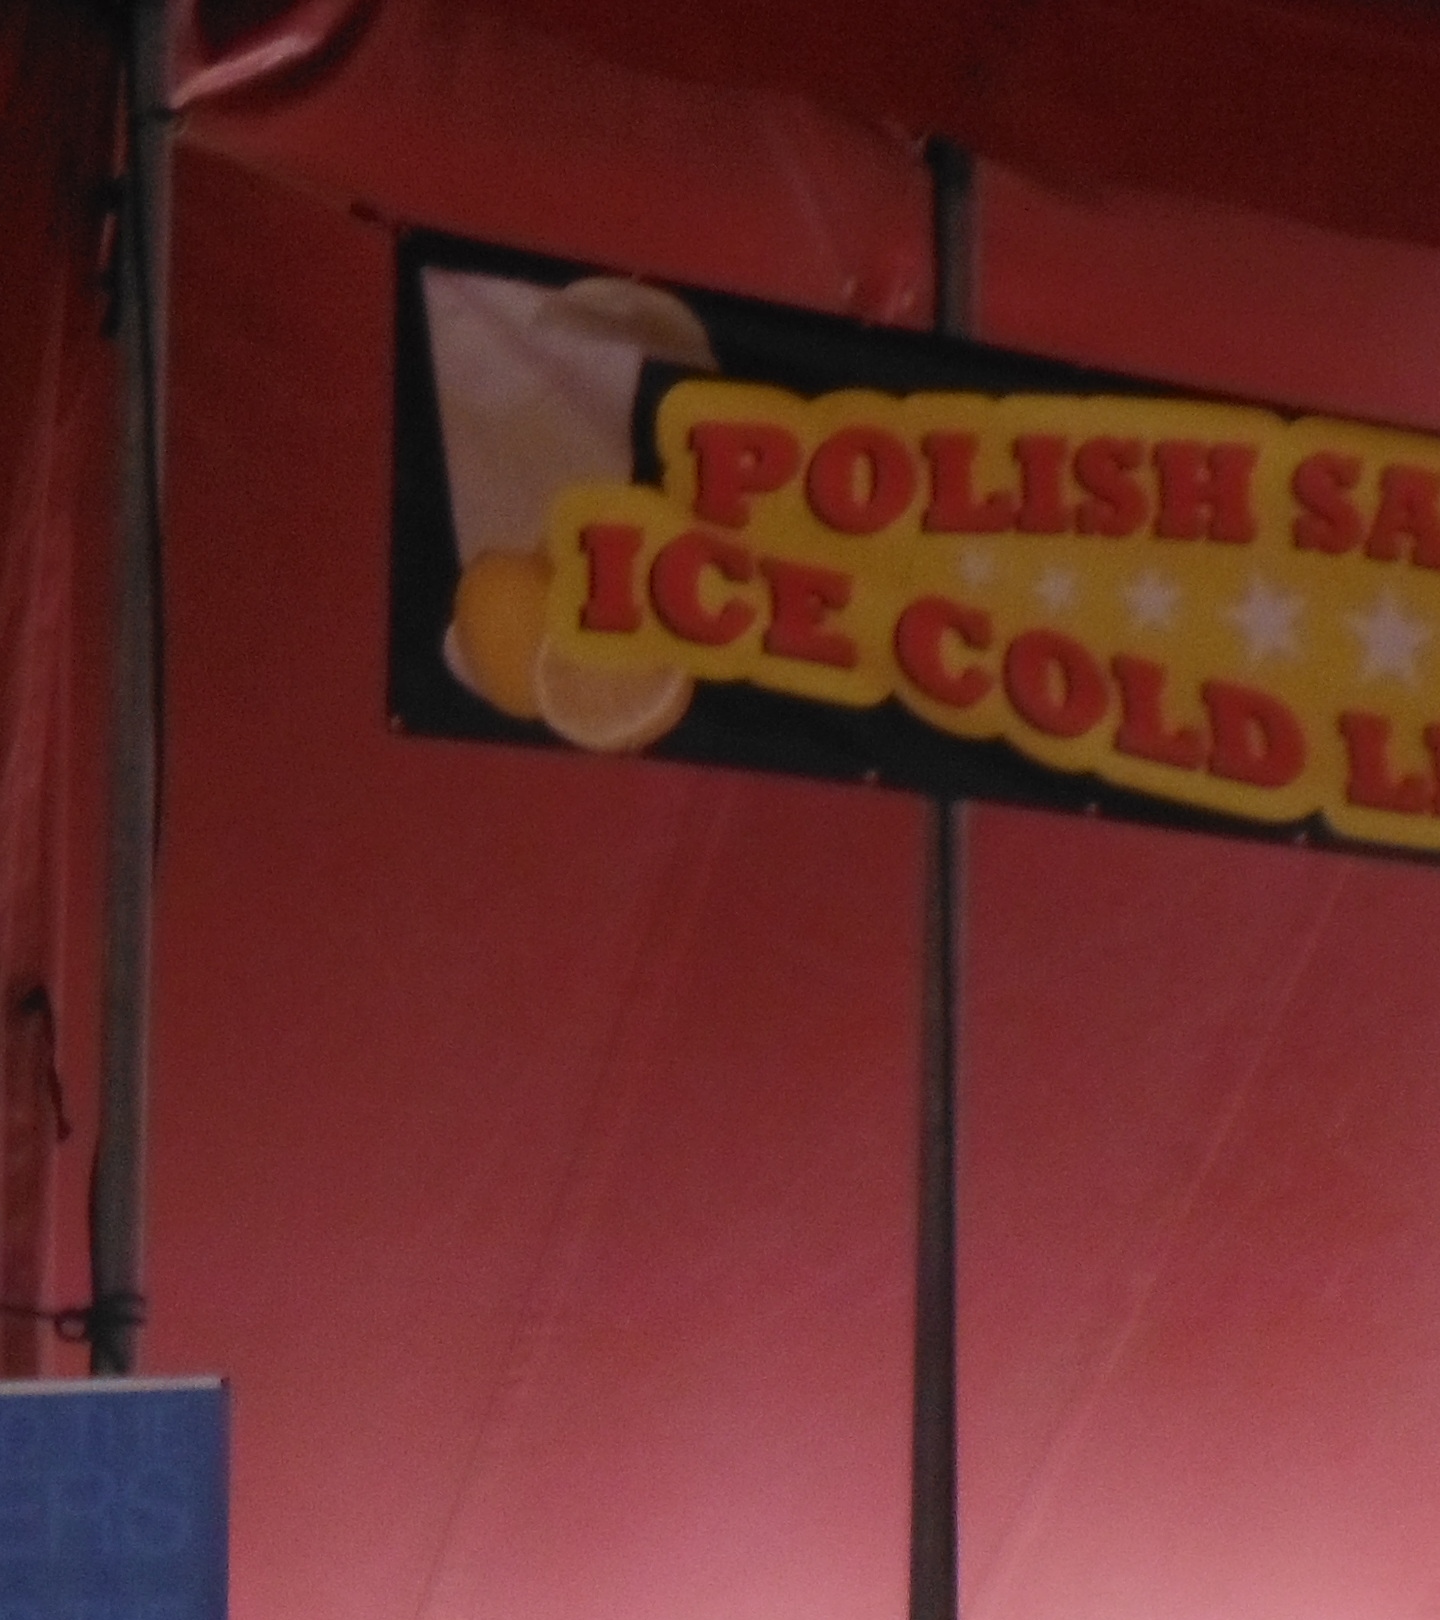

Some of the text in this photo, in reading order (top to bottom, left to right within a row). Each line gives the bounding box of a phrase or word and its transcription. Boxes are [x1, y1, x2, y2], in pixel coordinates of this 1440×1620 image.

[689, 419, 1259, 544] POLISH
[579, 523, 857, 669] ICE
[894, 595, 1308, 790] COLD
